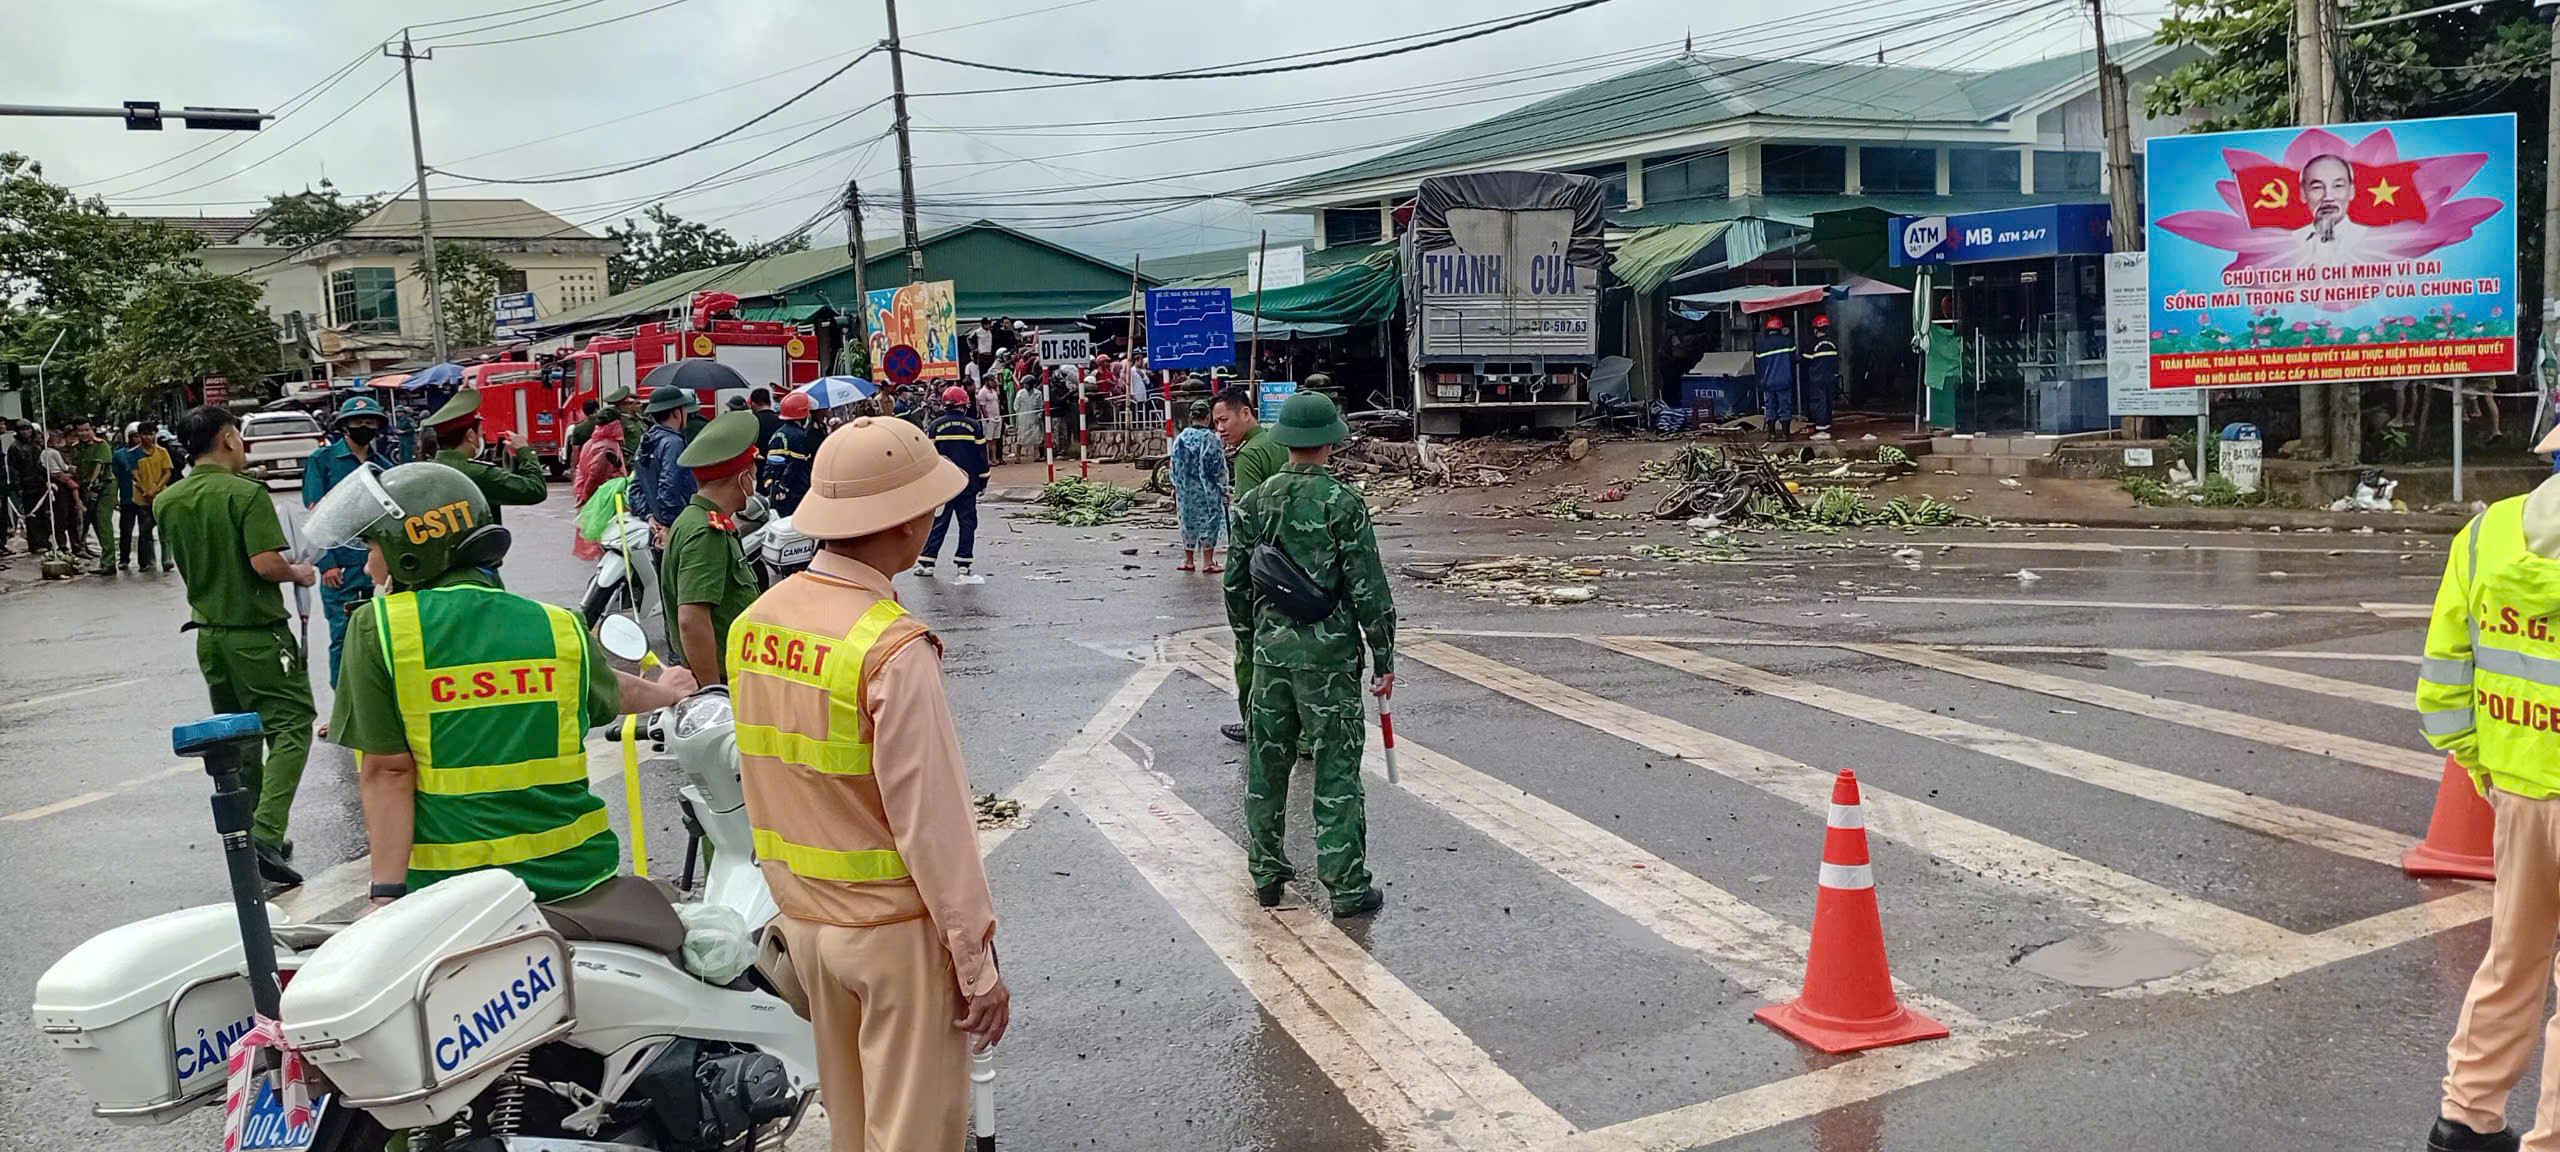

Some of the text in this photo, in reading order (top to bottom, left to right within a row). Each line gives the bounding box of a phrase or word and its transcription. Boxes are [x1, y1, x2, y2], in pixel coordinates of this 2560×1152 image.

[1909, 227, 1939, 244] ATM
[1965, 228, 2046, 246] MB ATM 24/7
[1425, 241, 1576, 294] THÀNH CỦA
[2223, 265, 2253, 286] CHỦ
[2352, 264, 2392, 279] MINH
[2165, 289, 2206, 310] SỐNG
[2245, 290, 2295, 306] TRONG
[2477, 279, 2500, 294] TA!
[1041, 339, 1087, 360] ĐT.586
[2407, 363, 2421, 374] XIV
[404, 500, 474, 545] CSTT
[741, 631, 832, 676] C.S.G.T
[431, 666, 556, 703] C.S.T.T
[436, 955, 557, 1072] CẢNH SÁT
